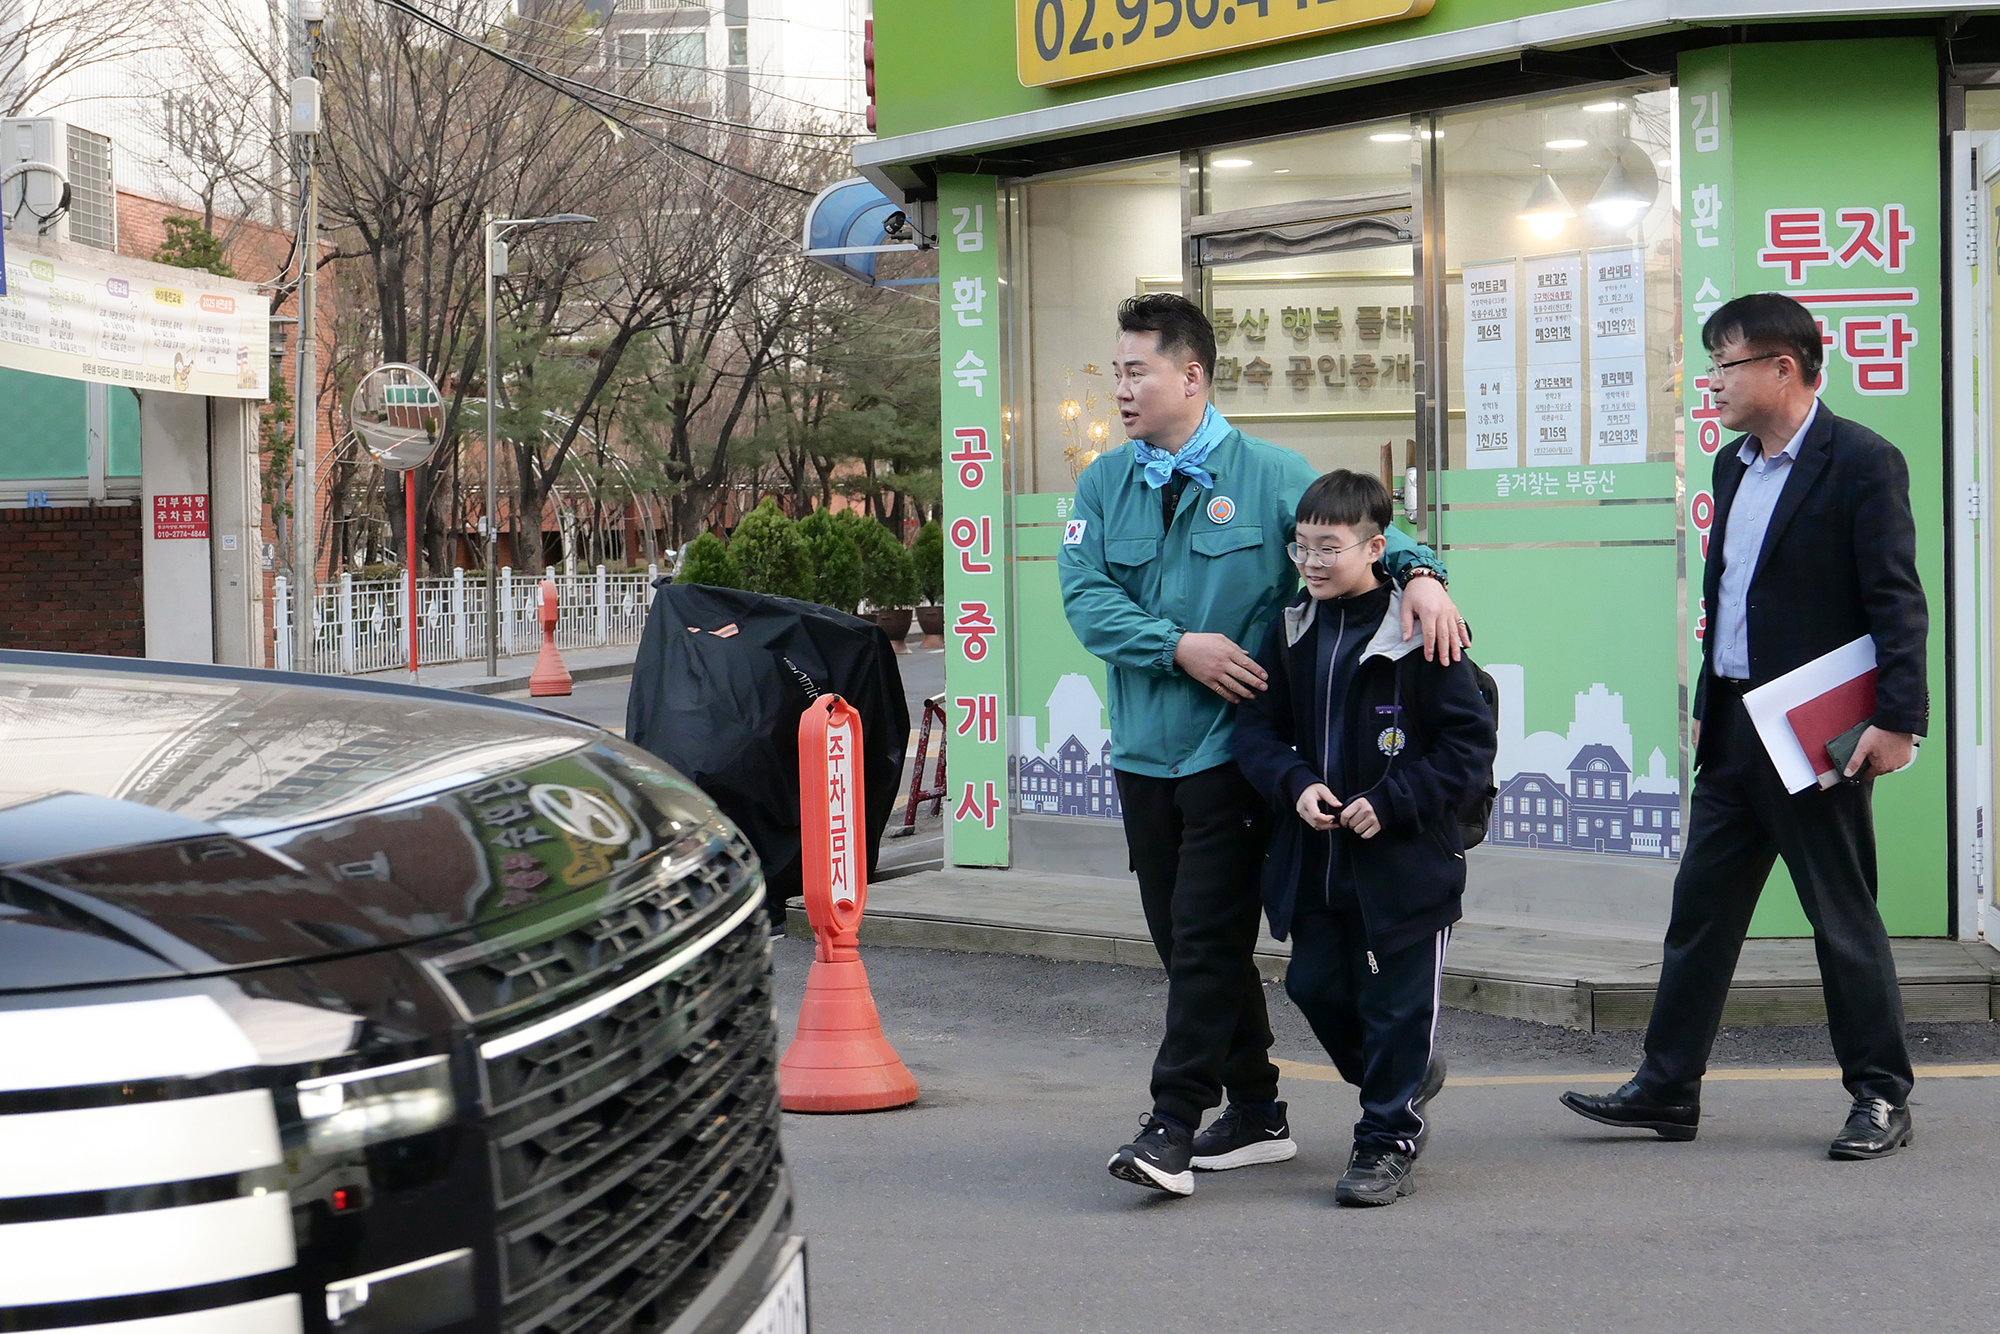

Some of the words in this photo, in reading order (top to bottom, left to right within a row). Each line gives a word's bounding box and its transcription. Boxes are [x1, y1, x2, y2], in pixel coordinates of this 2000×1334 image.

[1758, 204, 1914, 284] 투자
[1538, 273, 1567, 285] 빌라강추
[1599, 265, 1632, 279] 빌라매매
[1470, 279, 1507, 293] 아파트급매
[202, 298, 215, 308] 2025
[951, 204, 987, 397] 김환숙
[1281, 306, 1343, 340] 행복
[1597, 318, 1636, 334] 매1억9천
[1477, 324, 1502, 339] 매6억
[1535, 326, 1571, 341] 매3억1천
[1285, 354, 1414, 391] 공인중개
[1601, 371, 1633, 385] 빌라매매
[1477, 432, 1508, 449] 1천/55
[1540, 427, 1567, 440] 매15억
[1599, 429, 1638, 444] 매2억3천
[1495, 472, 1560, 497] 즐겨찾는
[1566, 470, 1616, 494] 부동산
[157, 496, 206, 508] 외부차량
[157, 510, 205, 522] 주차금지
[949, 426, 1000, 829] 공인중개사
[829, 735, 847, 891] 주차금지
